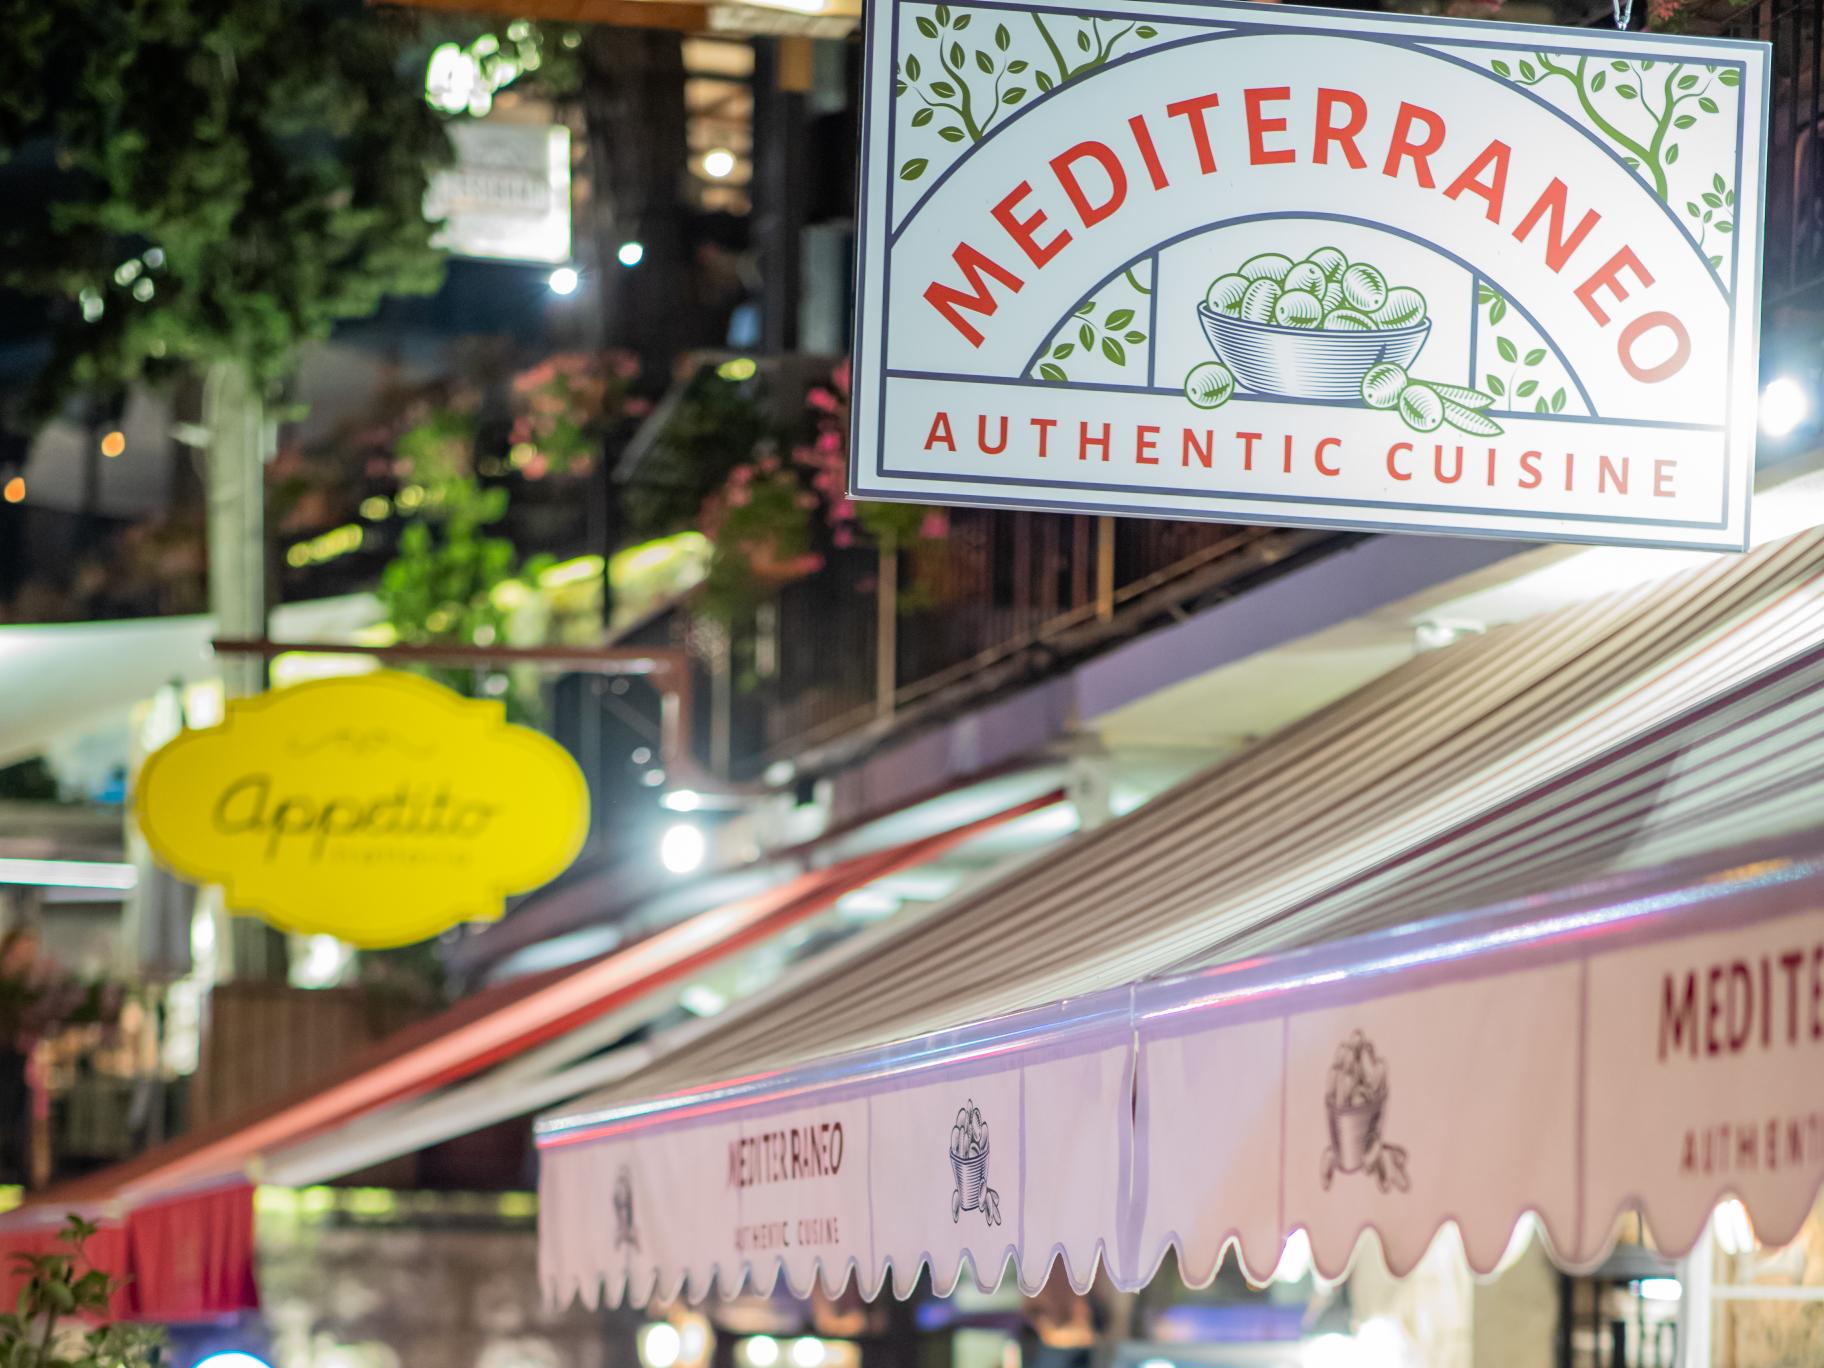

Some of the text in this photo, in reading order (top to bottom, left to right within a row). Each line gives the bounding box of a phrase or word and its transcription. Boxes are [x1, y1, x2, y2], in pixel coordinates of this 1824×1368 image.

[923, 85, 1691, 384] MEDITERRANEO
[923, 411, 1679, 500] AUTHENTIC CUISINE
